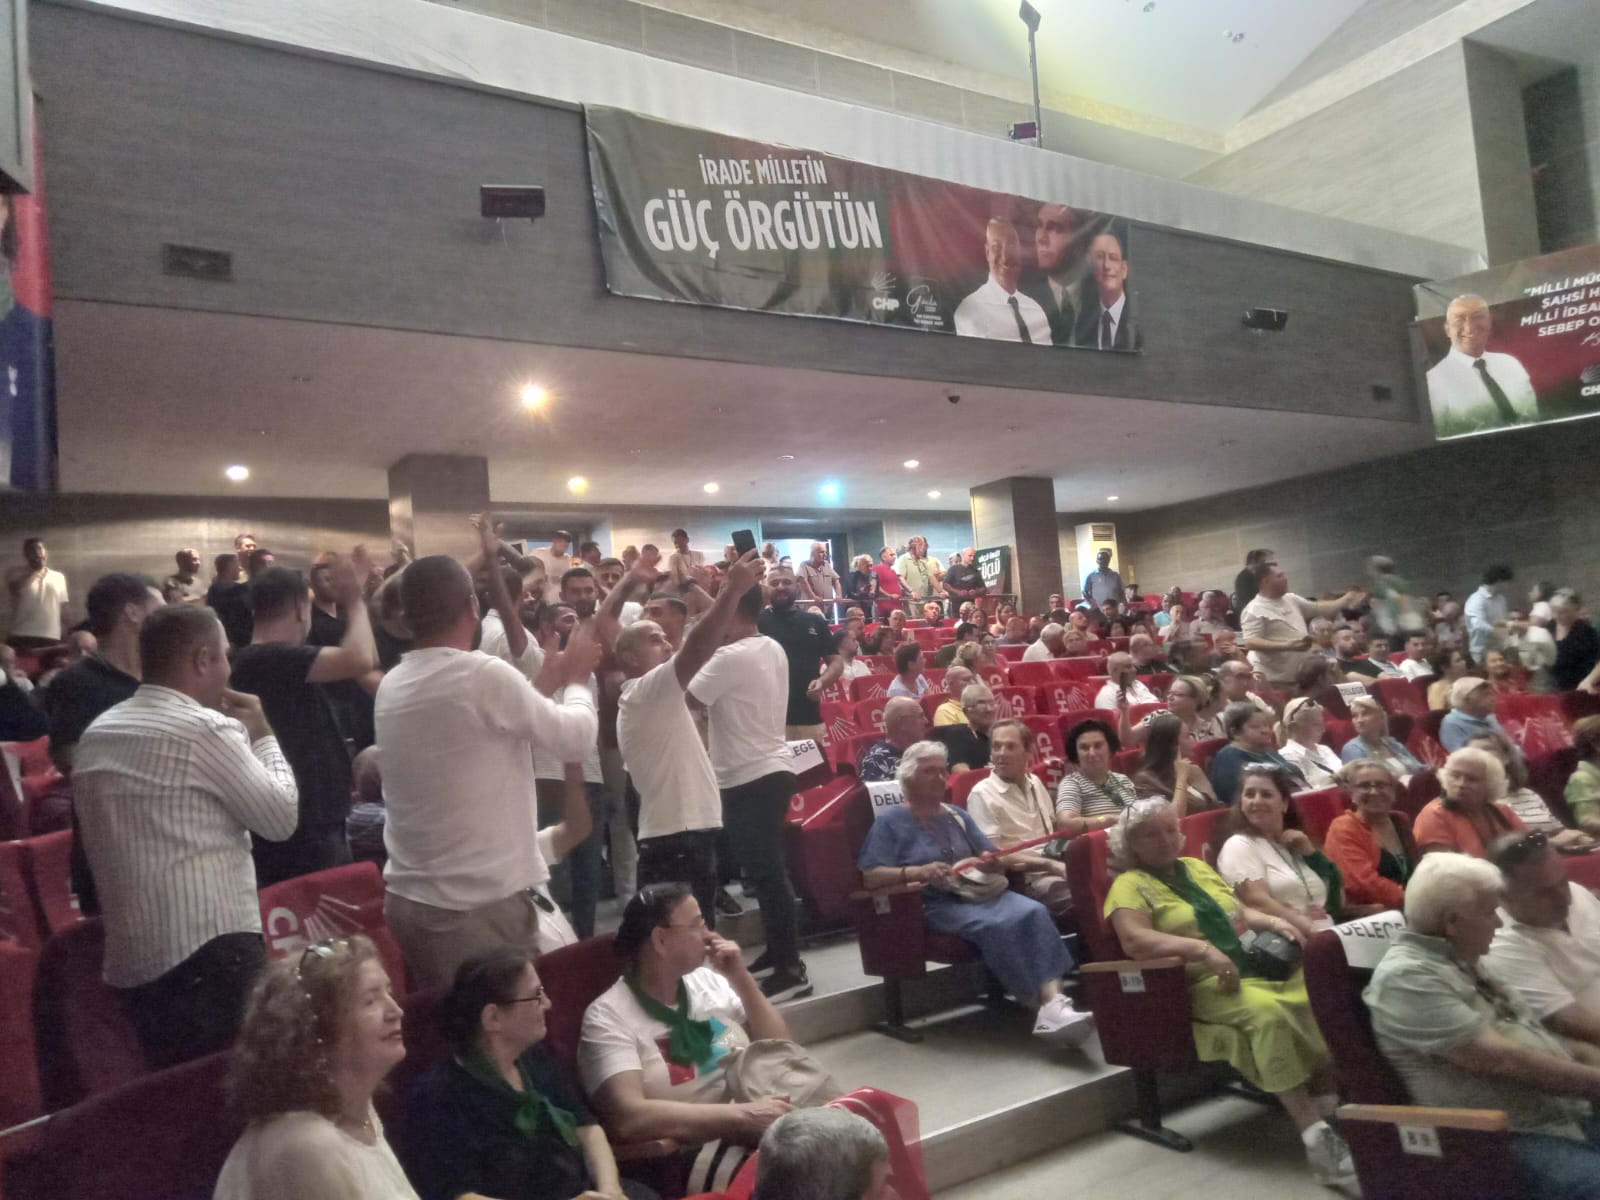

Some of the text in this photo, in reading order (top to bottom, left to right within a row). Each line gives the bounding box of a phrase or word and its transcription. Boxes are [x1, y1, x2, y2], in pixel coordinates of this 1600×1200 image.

[699, 154, 828, 185] İRADE MİLLETİN
[644, 188, 883, 259] GÜÇ ÖRGÜTÜN
[872, 297, 900, 311] CHP
[1541, 287, 1585, 310] ŞAHSİ
[1520, 301, 1600, 327] MİLLİ İDEA
[1537, 319, 1585, 337] SEBEP
[1581, 384, 1600, 397] CH
[978, 557, 1001, 580] ÜÇLÜ
[1054, 687, 1069, 713] CH
[792, 740, 816, 759] EGE
[873, 792, 905, 807] DEL
